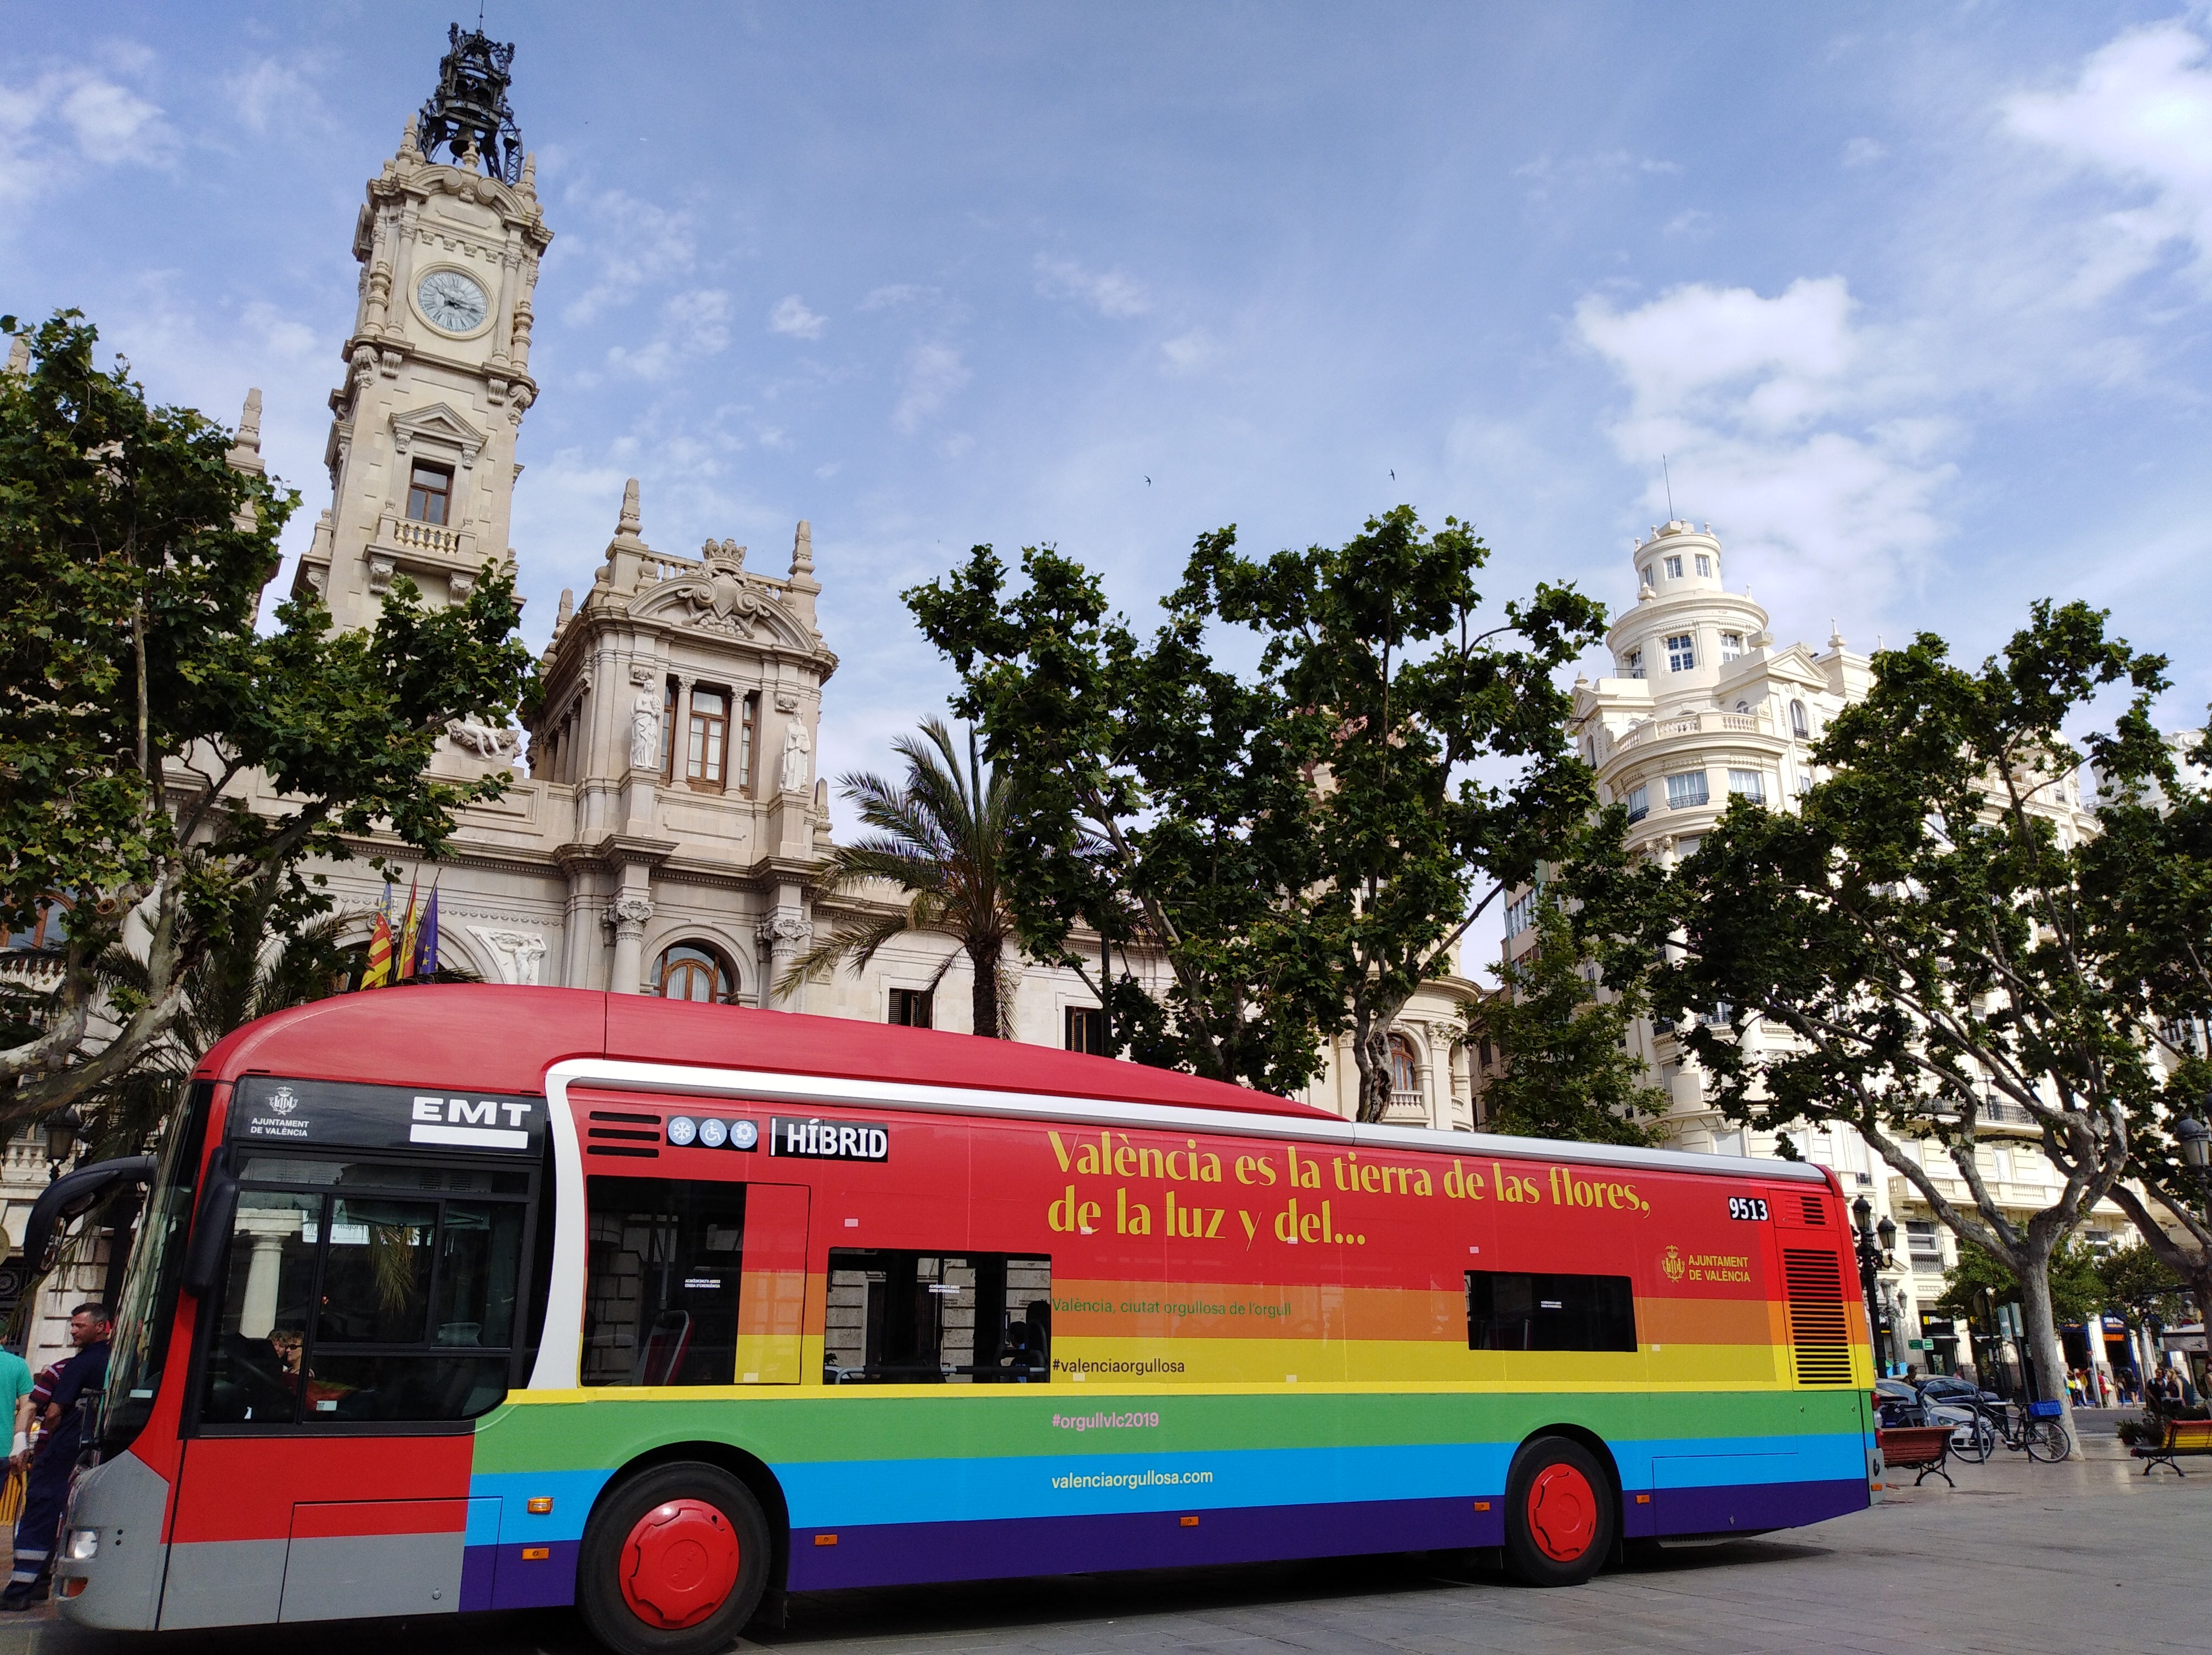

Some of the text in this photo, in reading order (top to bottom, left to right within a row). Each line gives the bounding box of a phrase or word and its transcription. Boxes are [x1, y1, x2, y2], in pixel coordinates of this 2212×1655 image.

[413, 1096, 531, 1126] EMT
[251, 1117, 309, 1128] AJUNTAMENT
[265, 1126, 308, 1137] VALÈNCIA
[787, 1118, 887, 1158] HÍBRID
[1047, 1130, 1651, 1219] València es la tierra de las flores,
[1048, 1184, 1366, 1252] de la luz y del...
[1729, 1197, 1768, 1221] 9513
[1688, 1254, 1748, 1268] AJUNTAMENT
[1689, 1268, 1751, 1282] DE VALÈNCIA
[1052, 1298, 1291, 1318] València, ciutat orgullosa de l'orgull
[1052, 1358, 1185, 1375] #valenciaorgullosa
[1052, 1412, 1159, 1432] #orgullvlc2019
[1051, 1470, 1213, 1489] valenciaorgullosa.com
